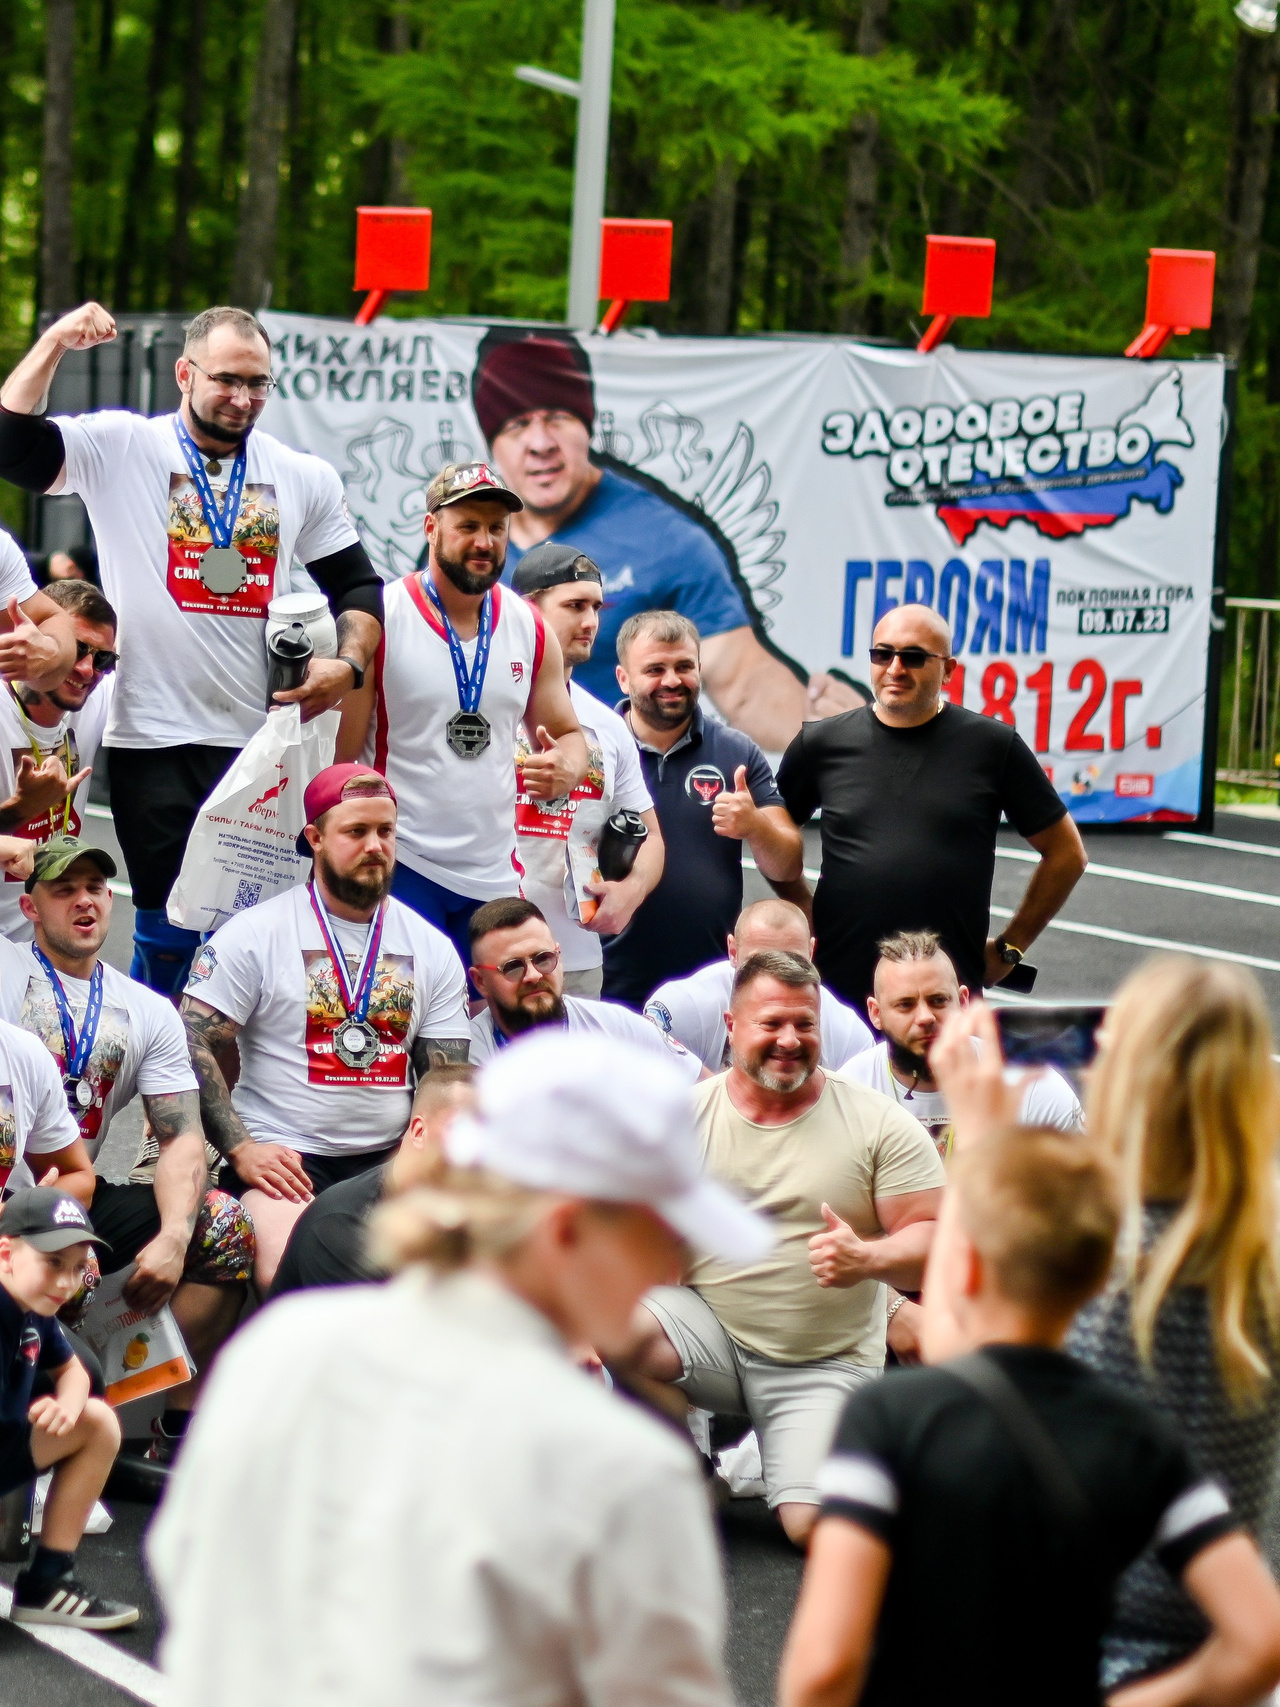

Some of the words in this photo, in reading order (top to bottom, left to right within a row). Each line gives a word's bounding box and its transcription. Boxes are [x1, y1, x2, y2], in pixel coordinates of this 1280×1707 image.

[887, 423, 1151, 487] ОТЕЧЕСТВО
[1056, 587, 1151, 606] ПОКЛОННАЯ
[1157, 585, 1195, 601] ГОРА
[1081, 608, 1168, 634] 09.07.23
